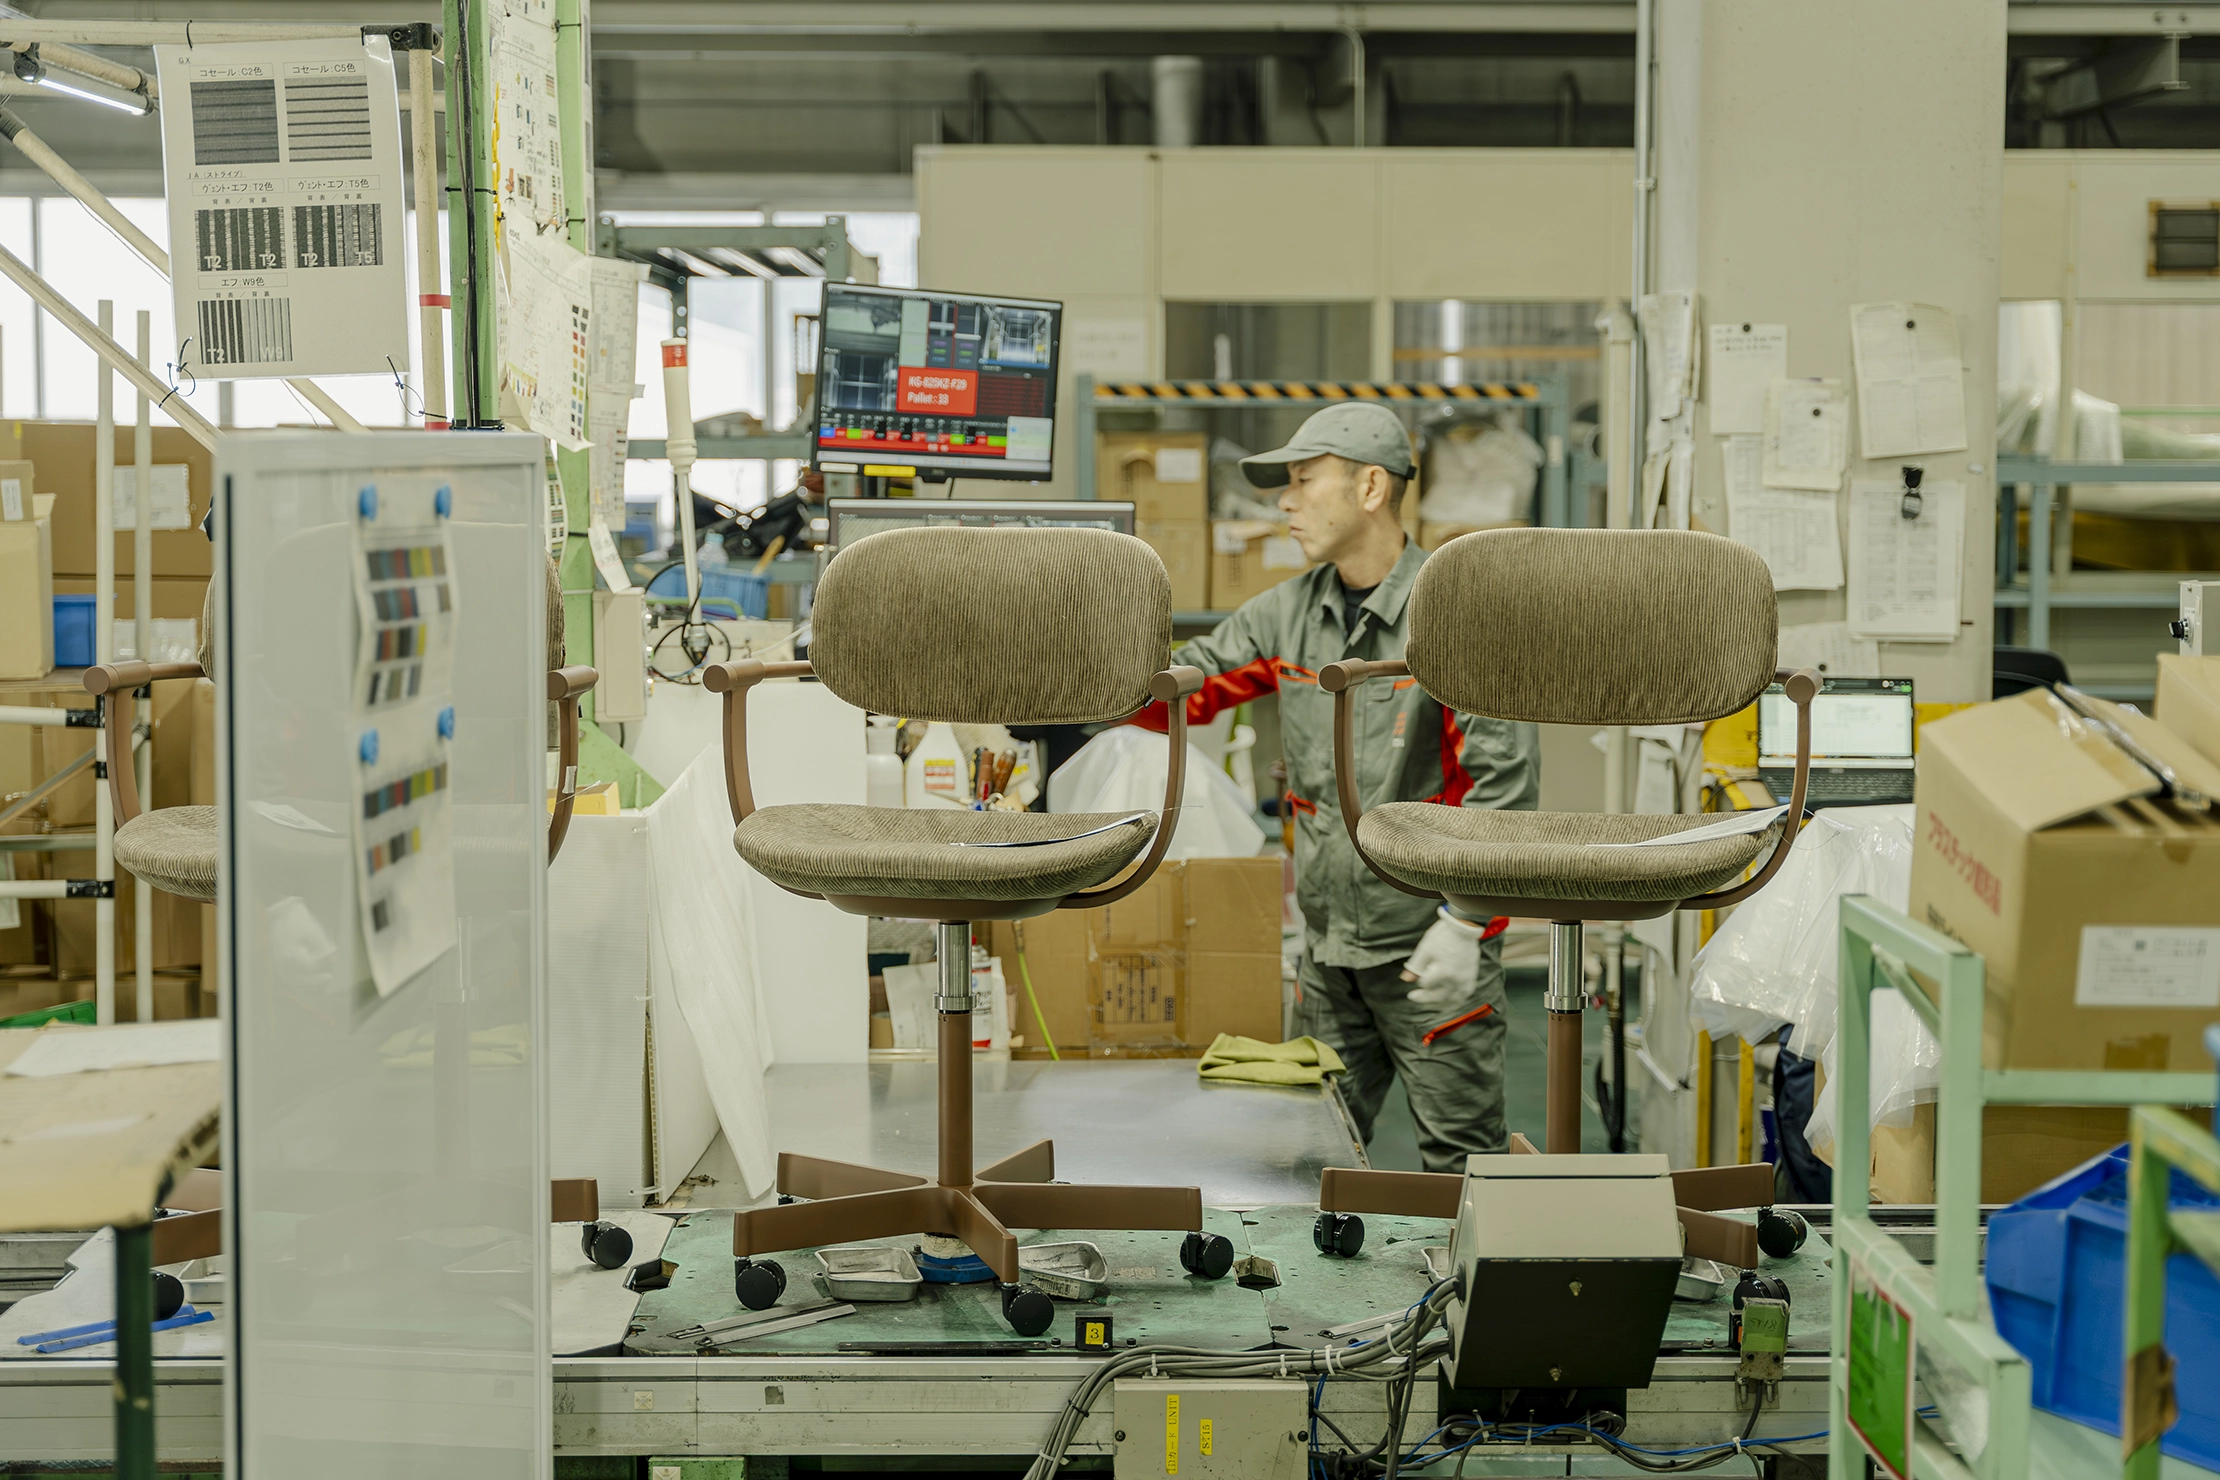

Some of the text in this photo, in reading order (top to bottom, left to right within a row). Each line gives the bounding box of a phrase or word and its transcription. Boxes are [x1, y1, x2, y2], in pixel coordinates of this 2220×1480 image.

[203, 254, 222, 270] T2
[258, 252, 277, 268] T2
[300, 252, 319, 267] T2
[206, 347, 226, 363] T2
[259, 345, 284, 361] W9
[1090, 1327, 1100, 1340] 3
